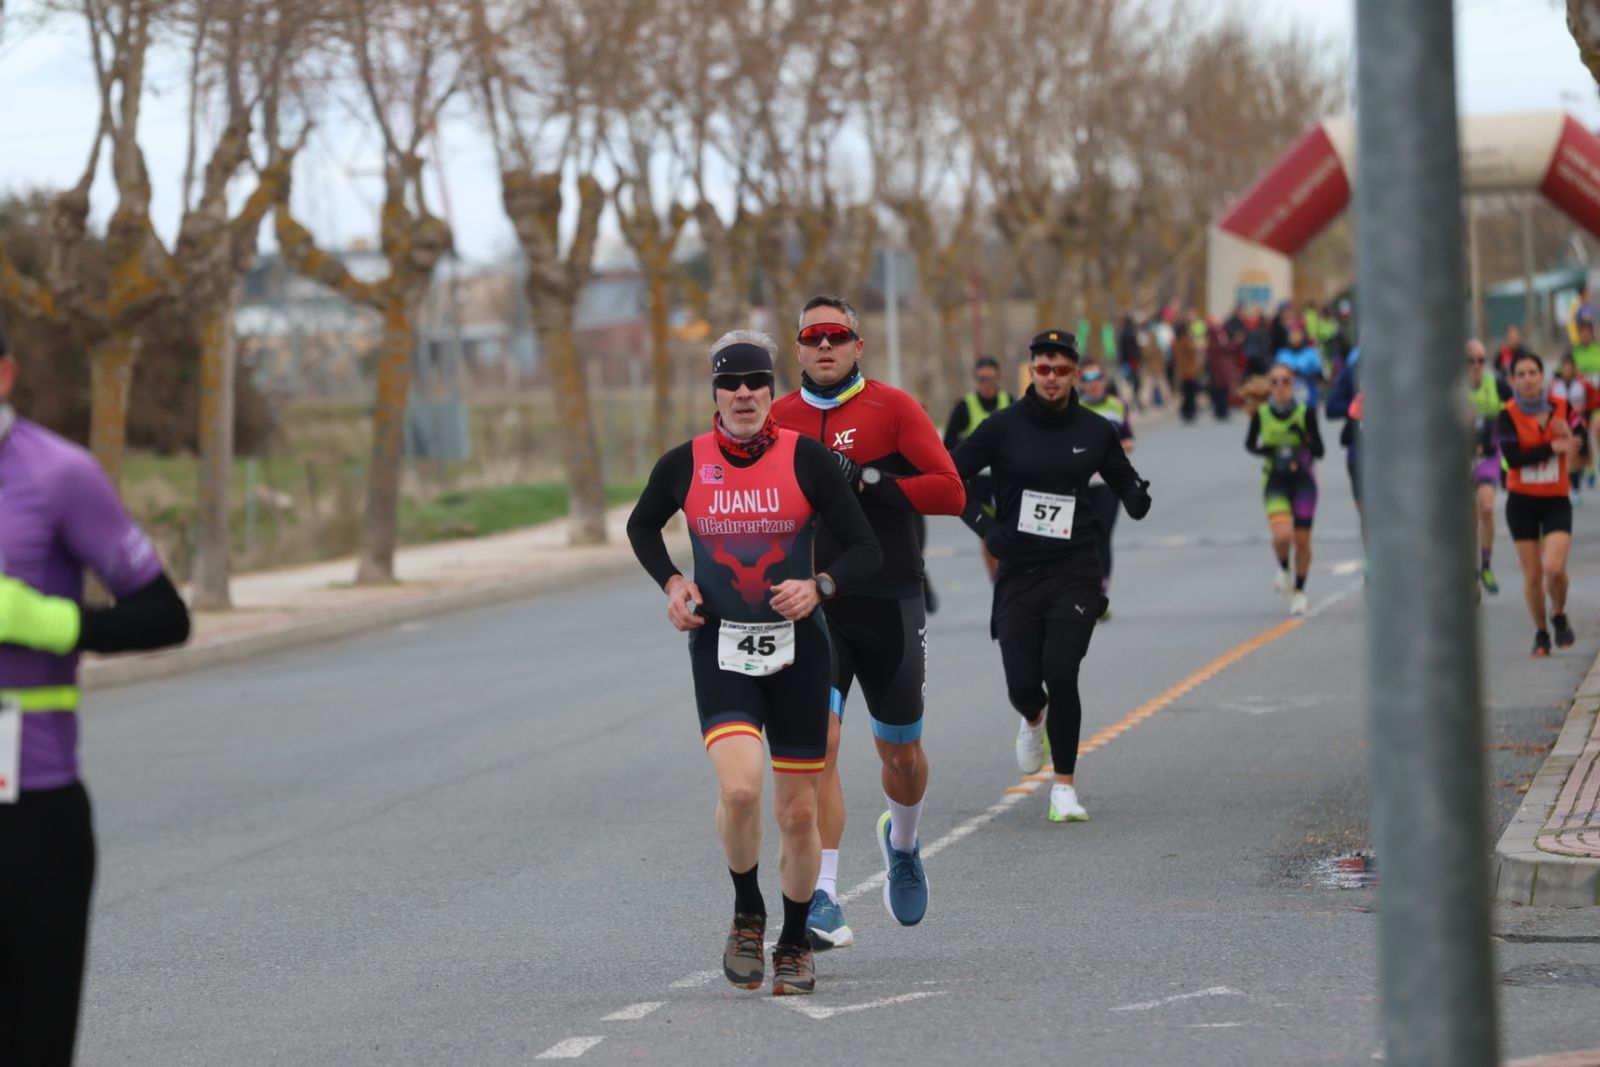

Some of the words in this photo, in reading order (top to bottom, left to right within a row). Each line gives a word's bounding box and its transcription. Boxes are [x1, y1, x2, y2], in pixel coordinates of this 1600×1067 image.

[708, 487, 780, 514] JUANLU
[1033, 503, 1062, 522] 57
[737, 634, 776, 656] 45
